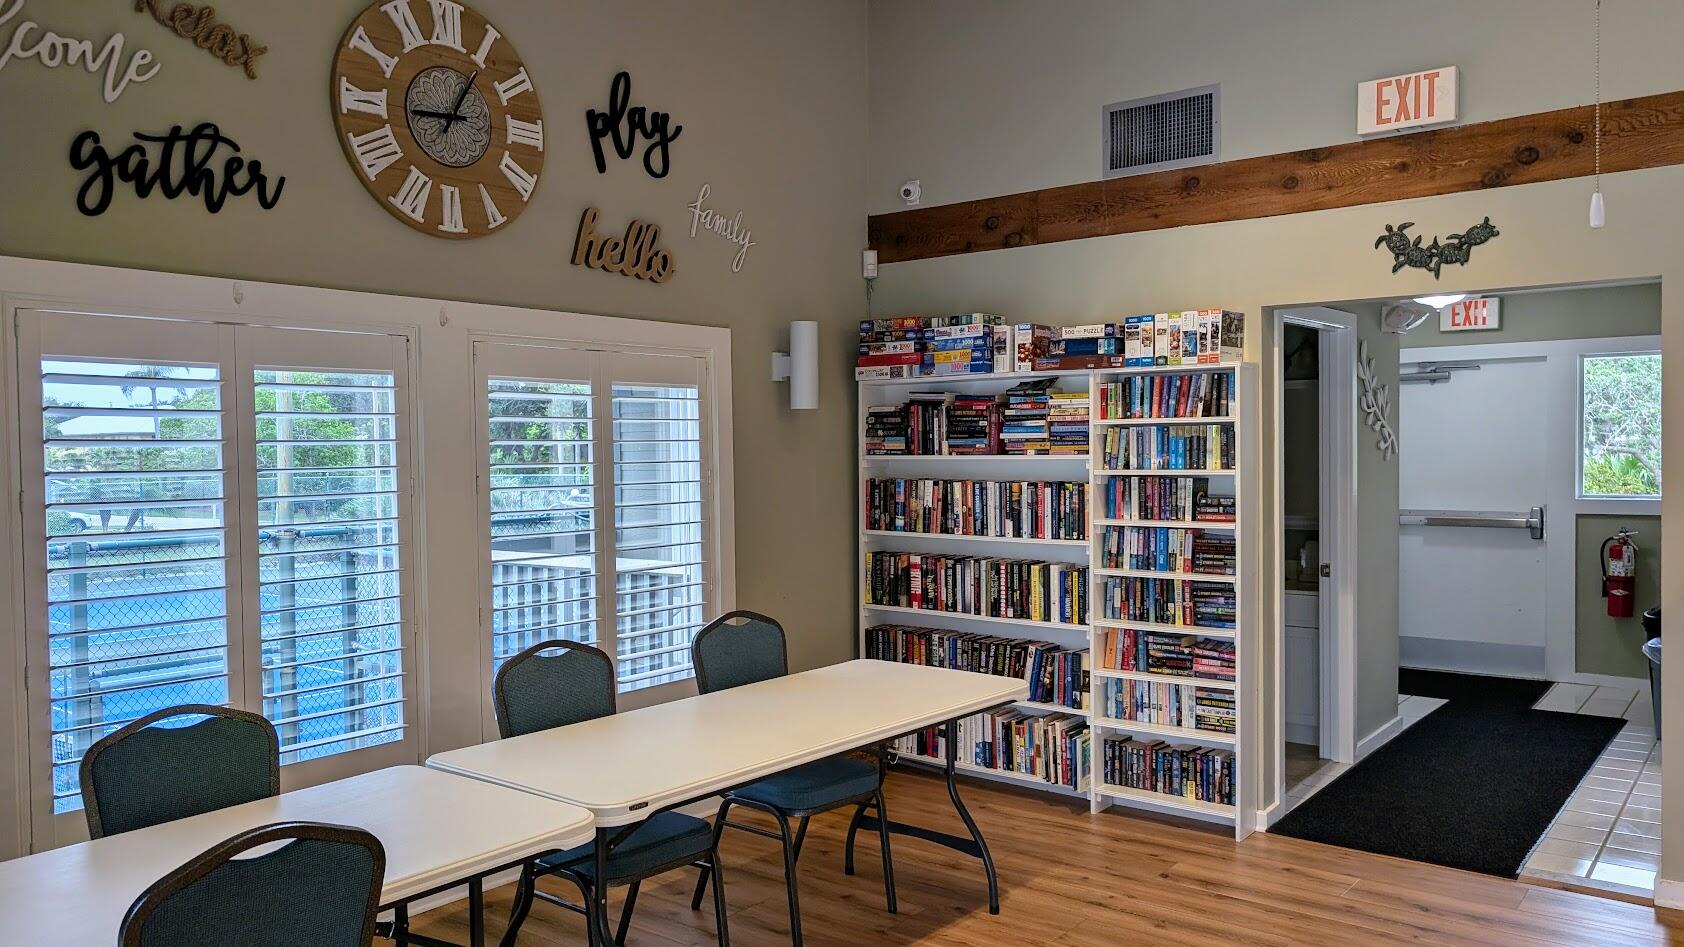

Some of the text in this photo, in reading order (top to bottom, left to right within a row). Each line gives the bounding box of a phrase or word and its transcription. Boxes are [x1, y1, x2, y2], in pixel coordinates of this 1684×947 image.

[349, 25, 399, 78] X
[428, 0, 467, 53] XII
[470, 23, 501, 69] I
[493, 66, 534, 106] II
[1375, 71, 1440, 126] EXIT
[505, 114, 543, 151] III
[586, 71, 683, 179] play
[70, 122, 286, 216] gather
[478, 183, 508, 229] V
[688, 183, 757, 273] family
[570, 207, 676, 284] hello
[1451, 300, 1488, 327] EXIT
